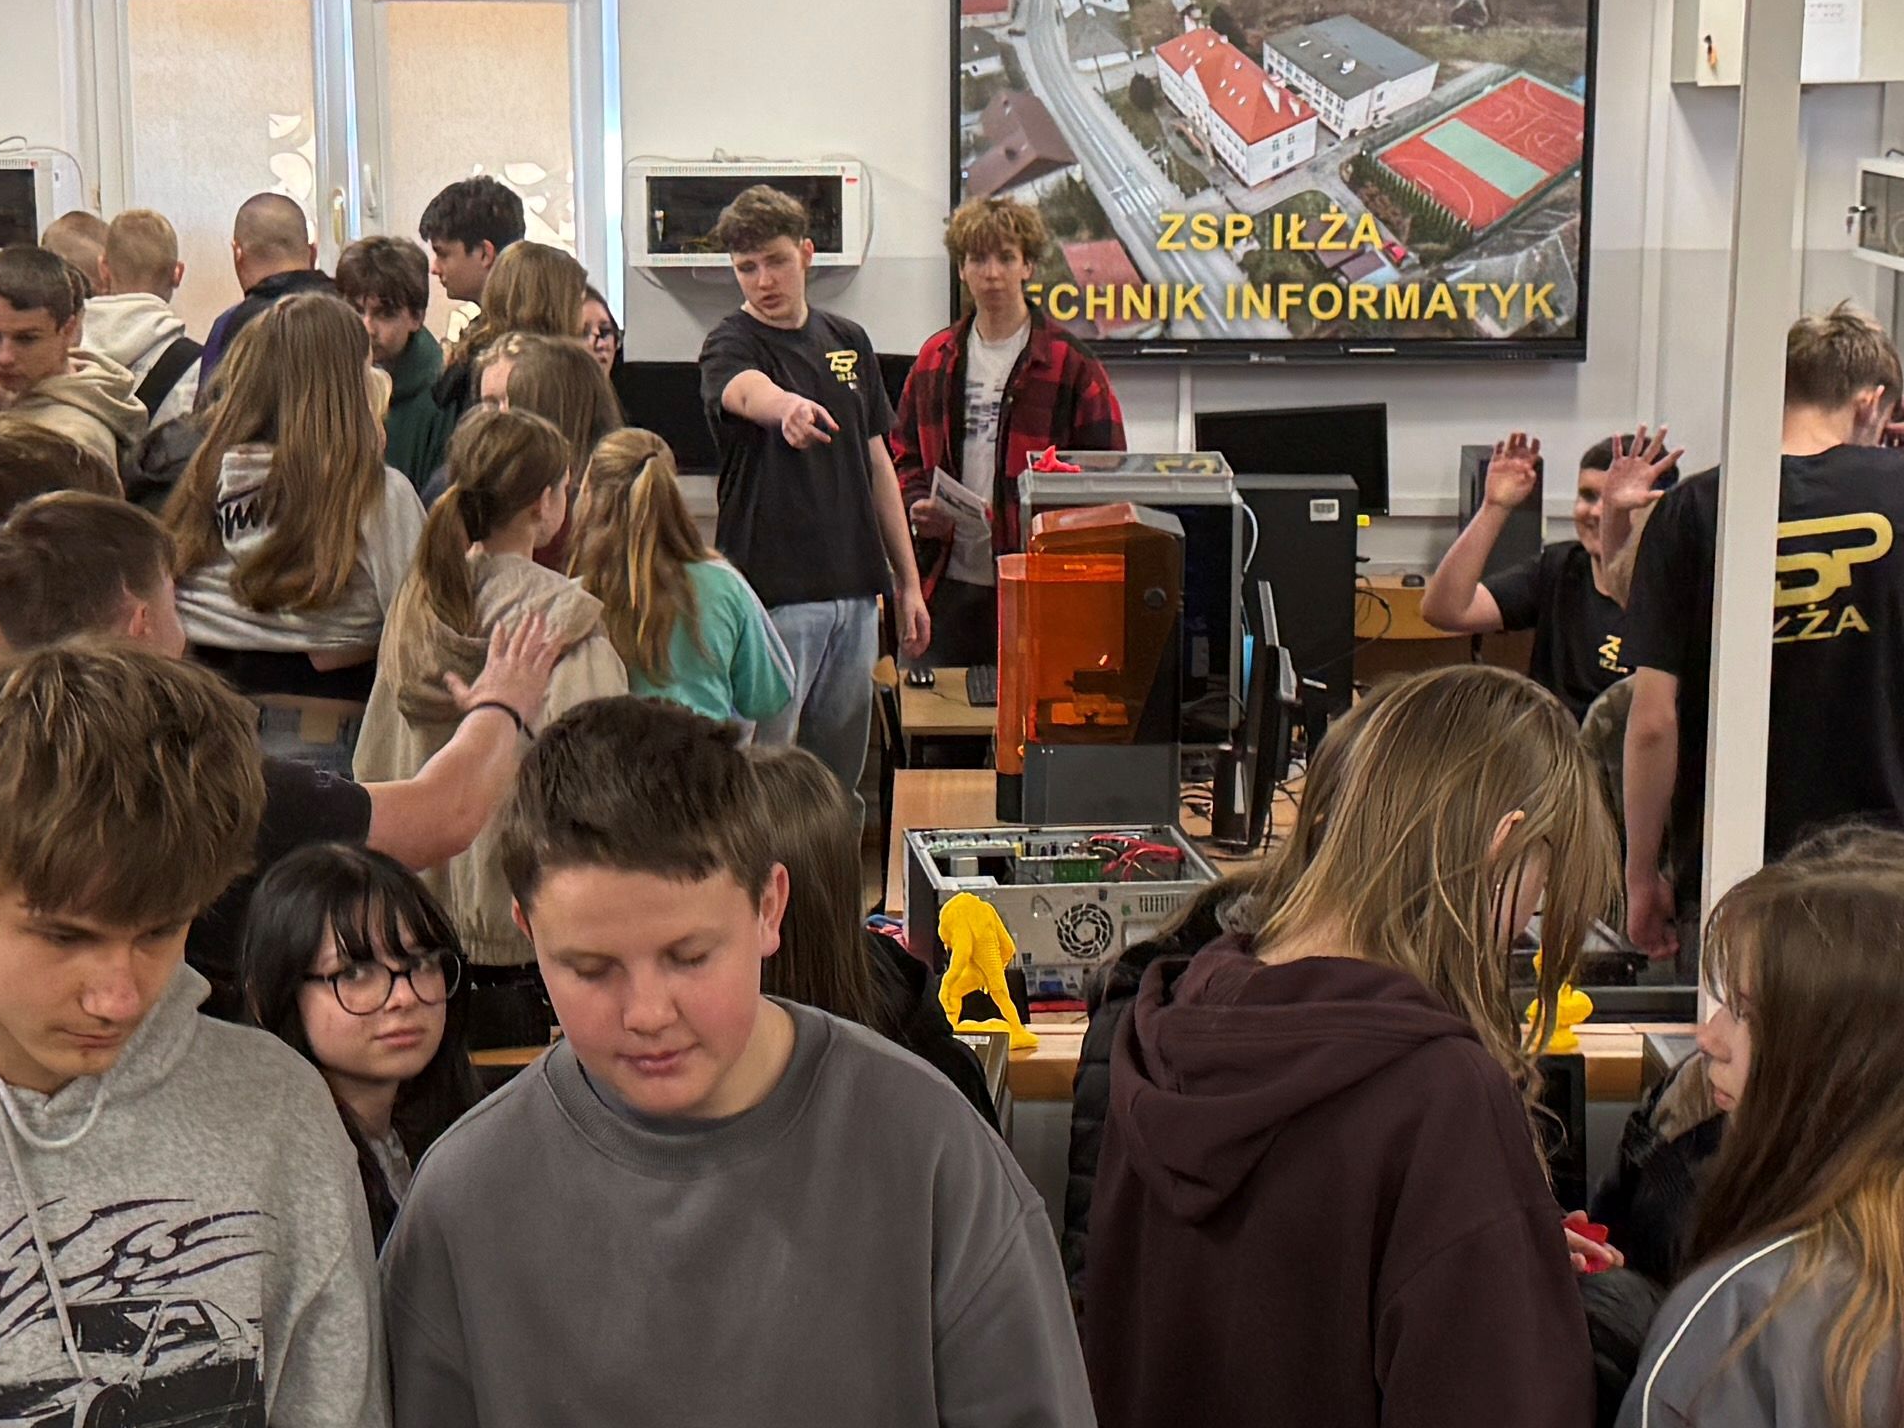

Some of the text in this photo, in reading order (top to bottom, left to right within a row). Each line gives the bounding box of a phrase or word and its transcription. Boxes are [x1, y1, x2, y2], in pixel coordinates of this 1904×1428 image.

[1156, 205, 1384, 251] ZSP IŁŻA
[1027, 282, 1558, 321] CHNIK INFORMATYK
[1773, 603, 1871, 644] ŻA
